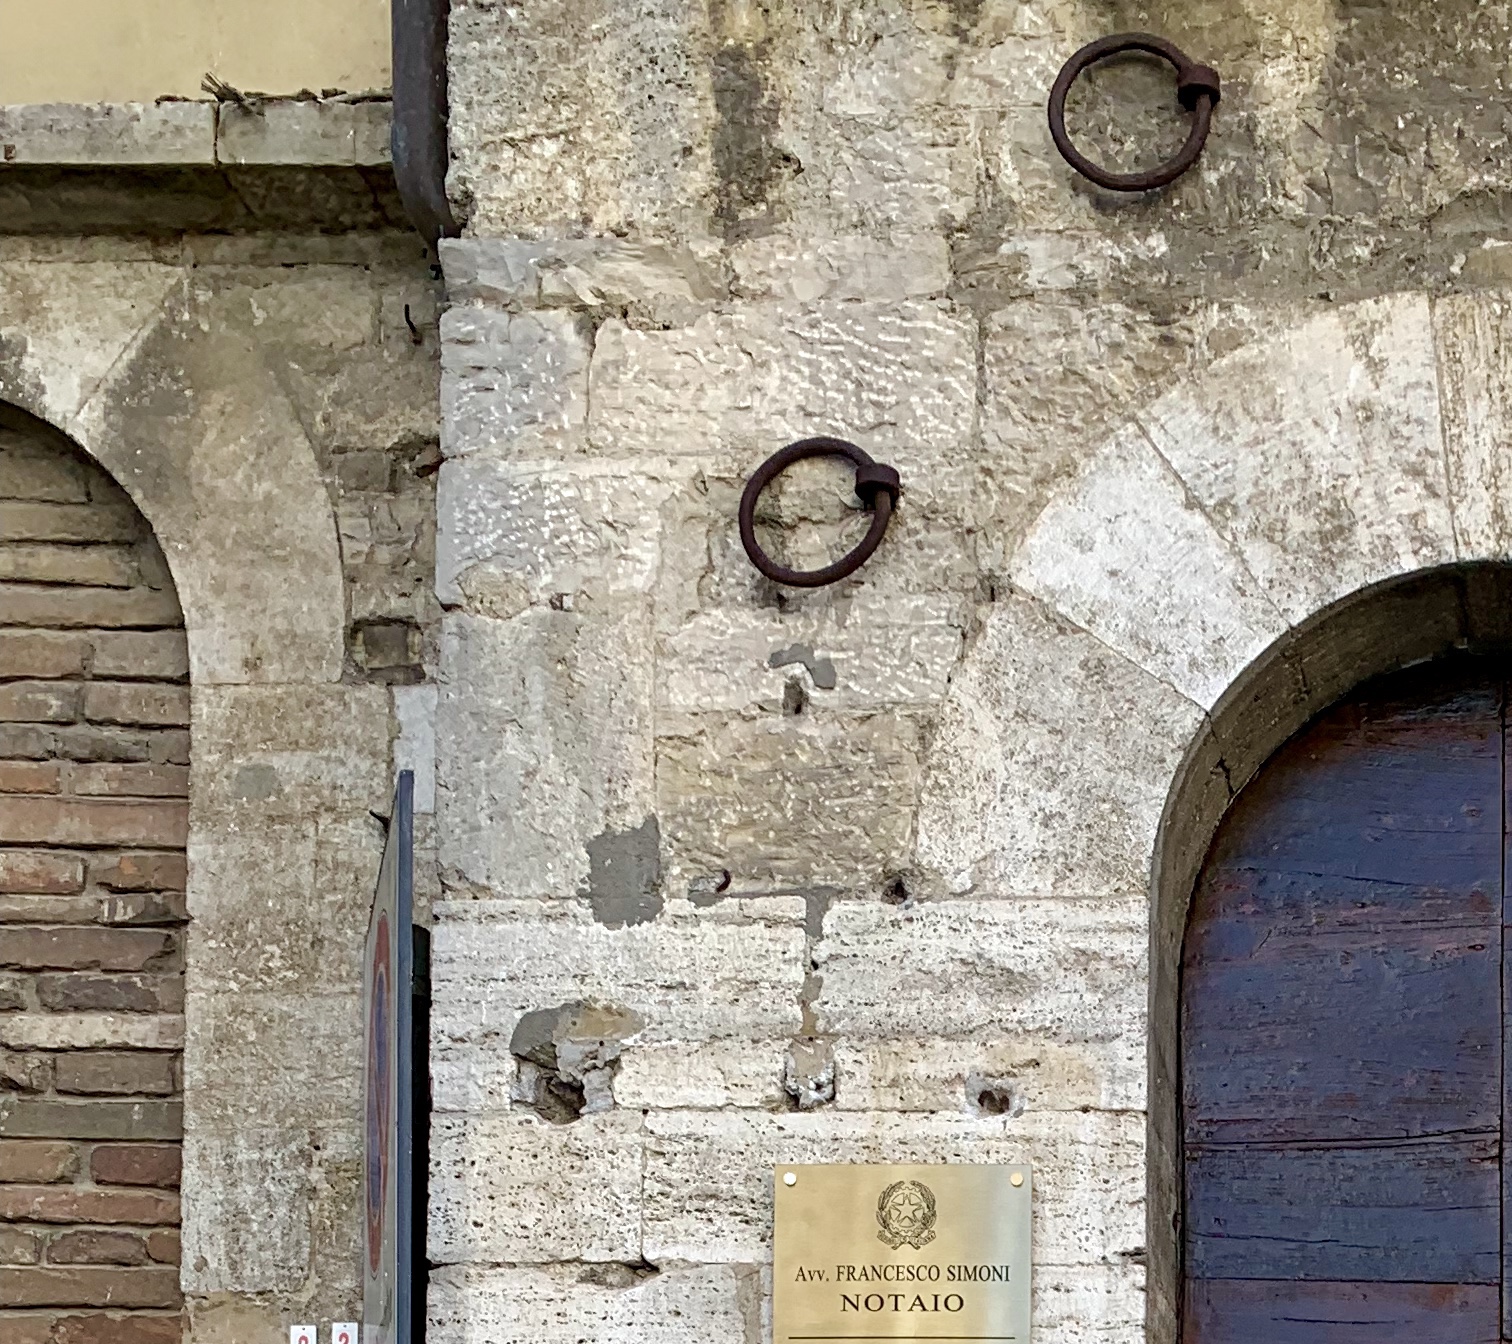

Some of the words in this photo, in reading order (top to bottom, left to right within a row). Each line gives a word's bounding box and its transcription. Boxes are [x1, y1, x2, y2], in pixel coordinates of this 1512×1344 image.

[836, 1264, 940, 1282] FRANCESCO
[946, 1264, 1010, 1282] SIMONI
[840, 1293, 965, 1313] NOTAIO
